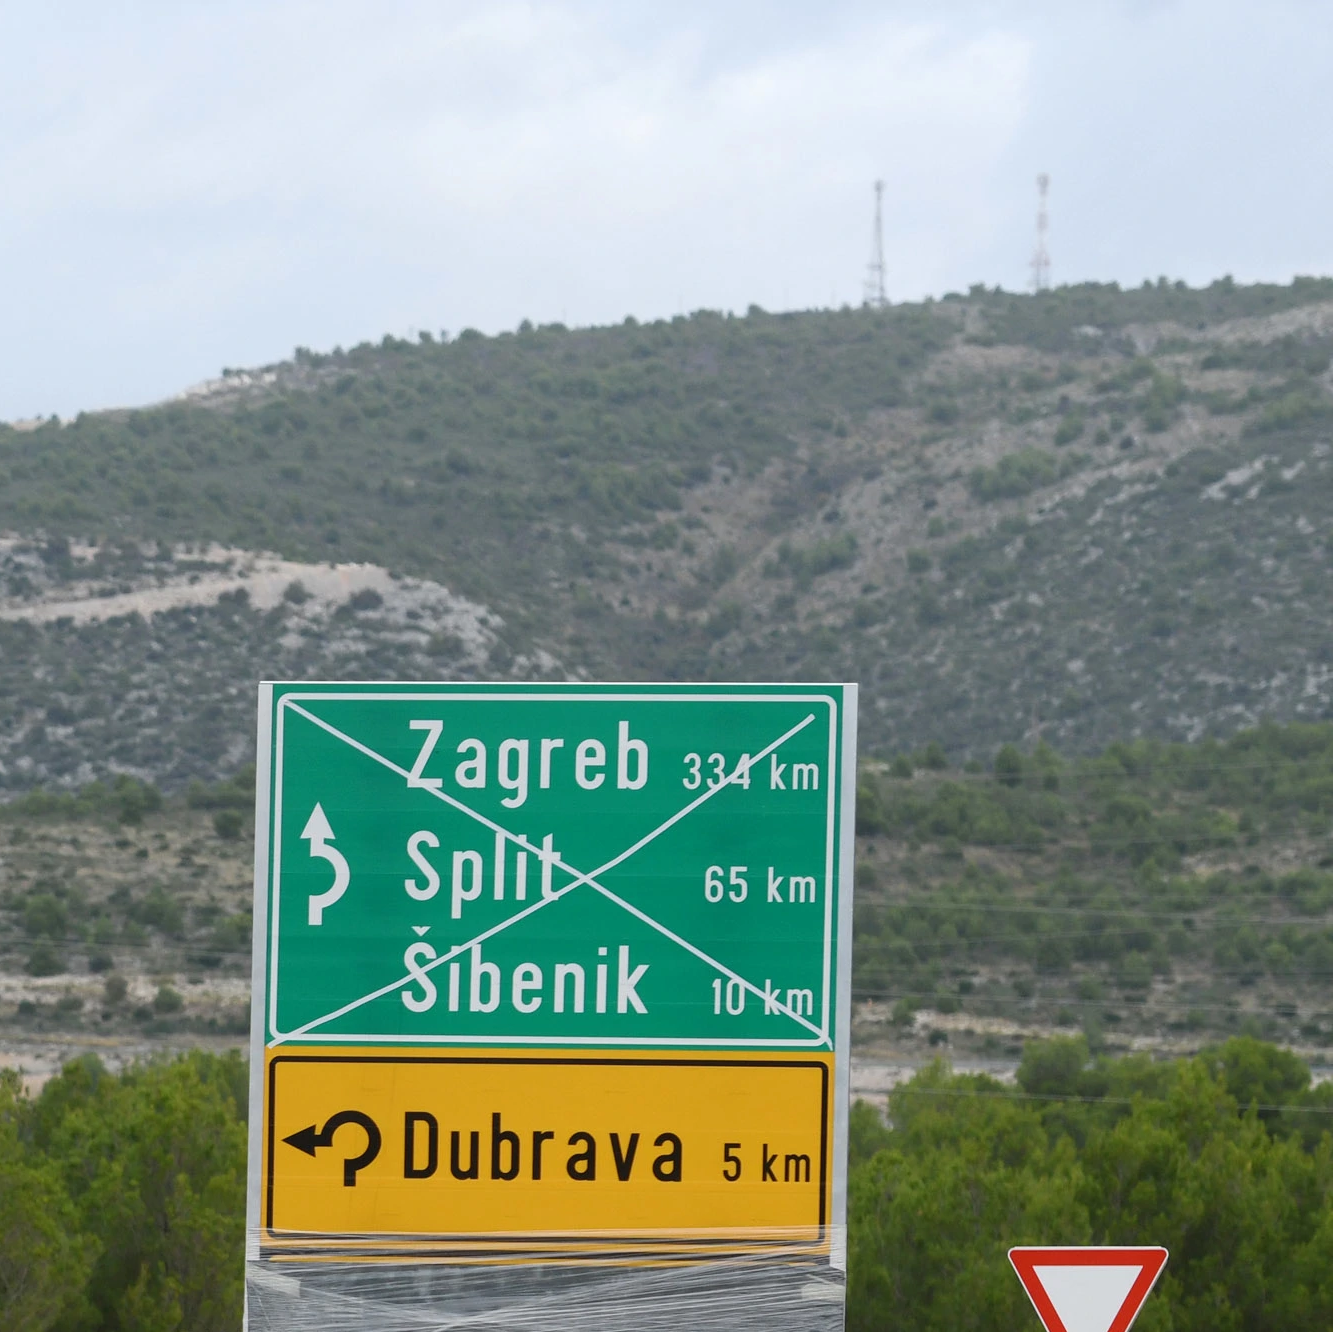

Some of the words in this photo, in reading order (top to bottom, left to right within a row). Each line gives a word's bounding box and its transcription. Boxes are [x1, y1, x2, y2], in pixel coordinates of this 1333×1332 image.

[406, 719, 650, 808] Zagreb
[683, 752, 752, 791] 334
[770, 753, 820, 791] km
[404, 830, 562, 919] Split
[704, 866, 749, 903] 65
[767, 866, 817, 904] km
[401, 926, 651, 1015] Šibenik
[711, 979, 745, 1016] 10
[765, 980, 814, 1016] km
[403, 1111, 683, 1183] Dubrava
[722, 1143, 741, 1182] 5
[761, 1144, 811, 1183] km
